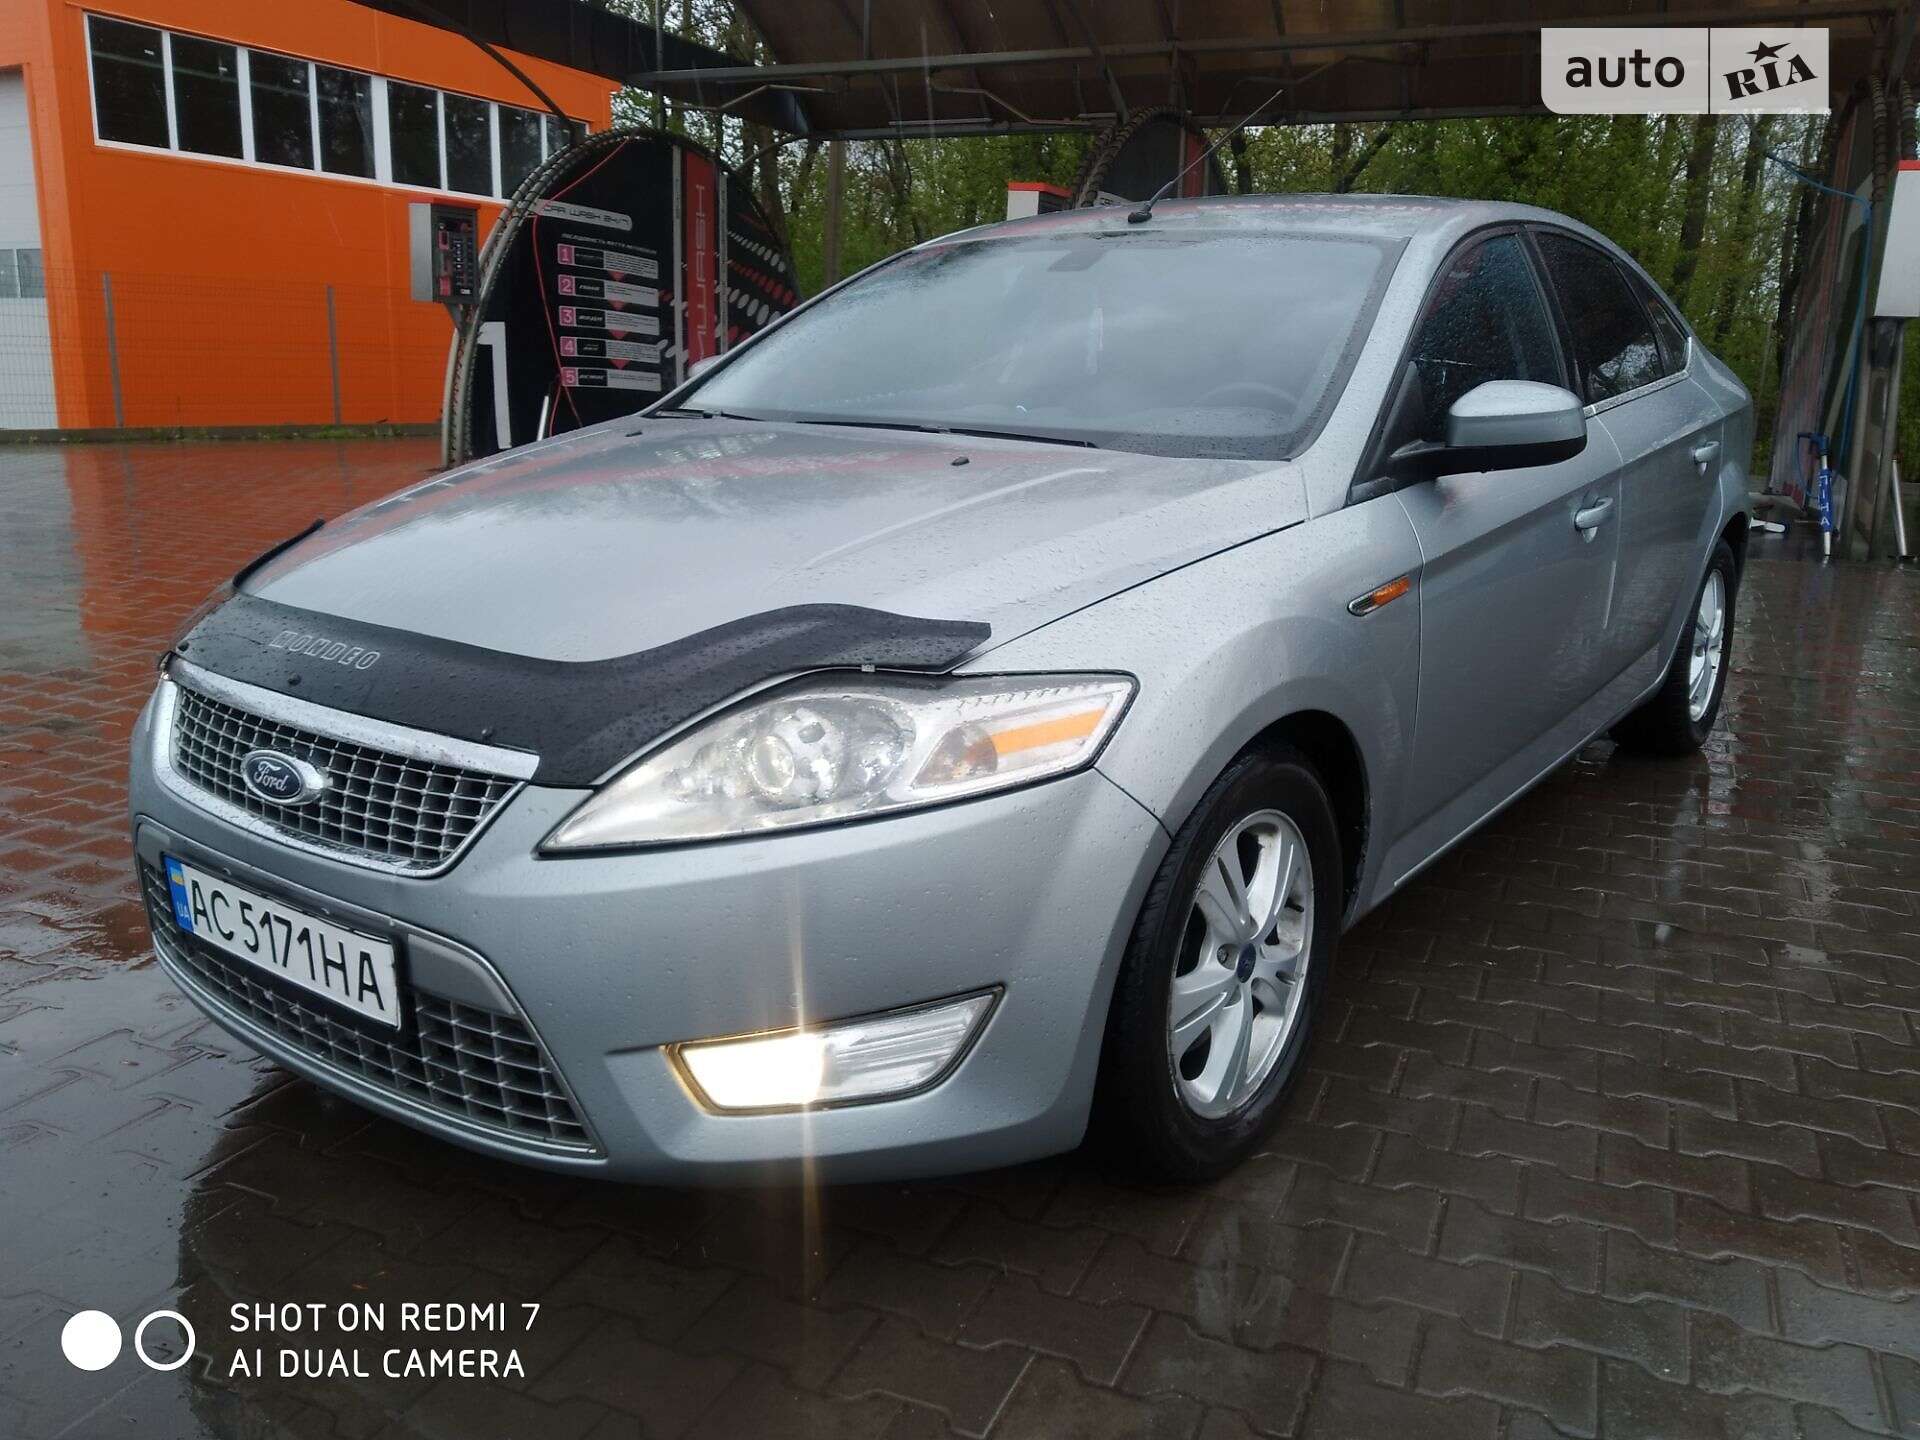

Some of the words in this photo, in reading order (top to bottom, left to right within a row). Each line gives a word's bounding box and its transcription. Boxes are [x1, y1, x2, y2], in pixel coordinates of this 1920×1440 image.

[569, 208, 601, 220] WASH
[561, 278, 573, 293] 2
[562, 307, 574, 324] 3
[563, 339, 576, 354] 4
[565, 369, 576, 384] 5
[478, 321, 512, 449] 1
[253, 760, 290, 793] Ford
[176, 902, 192, 923] UA
